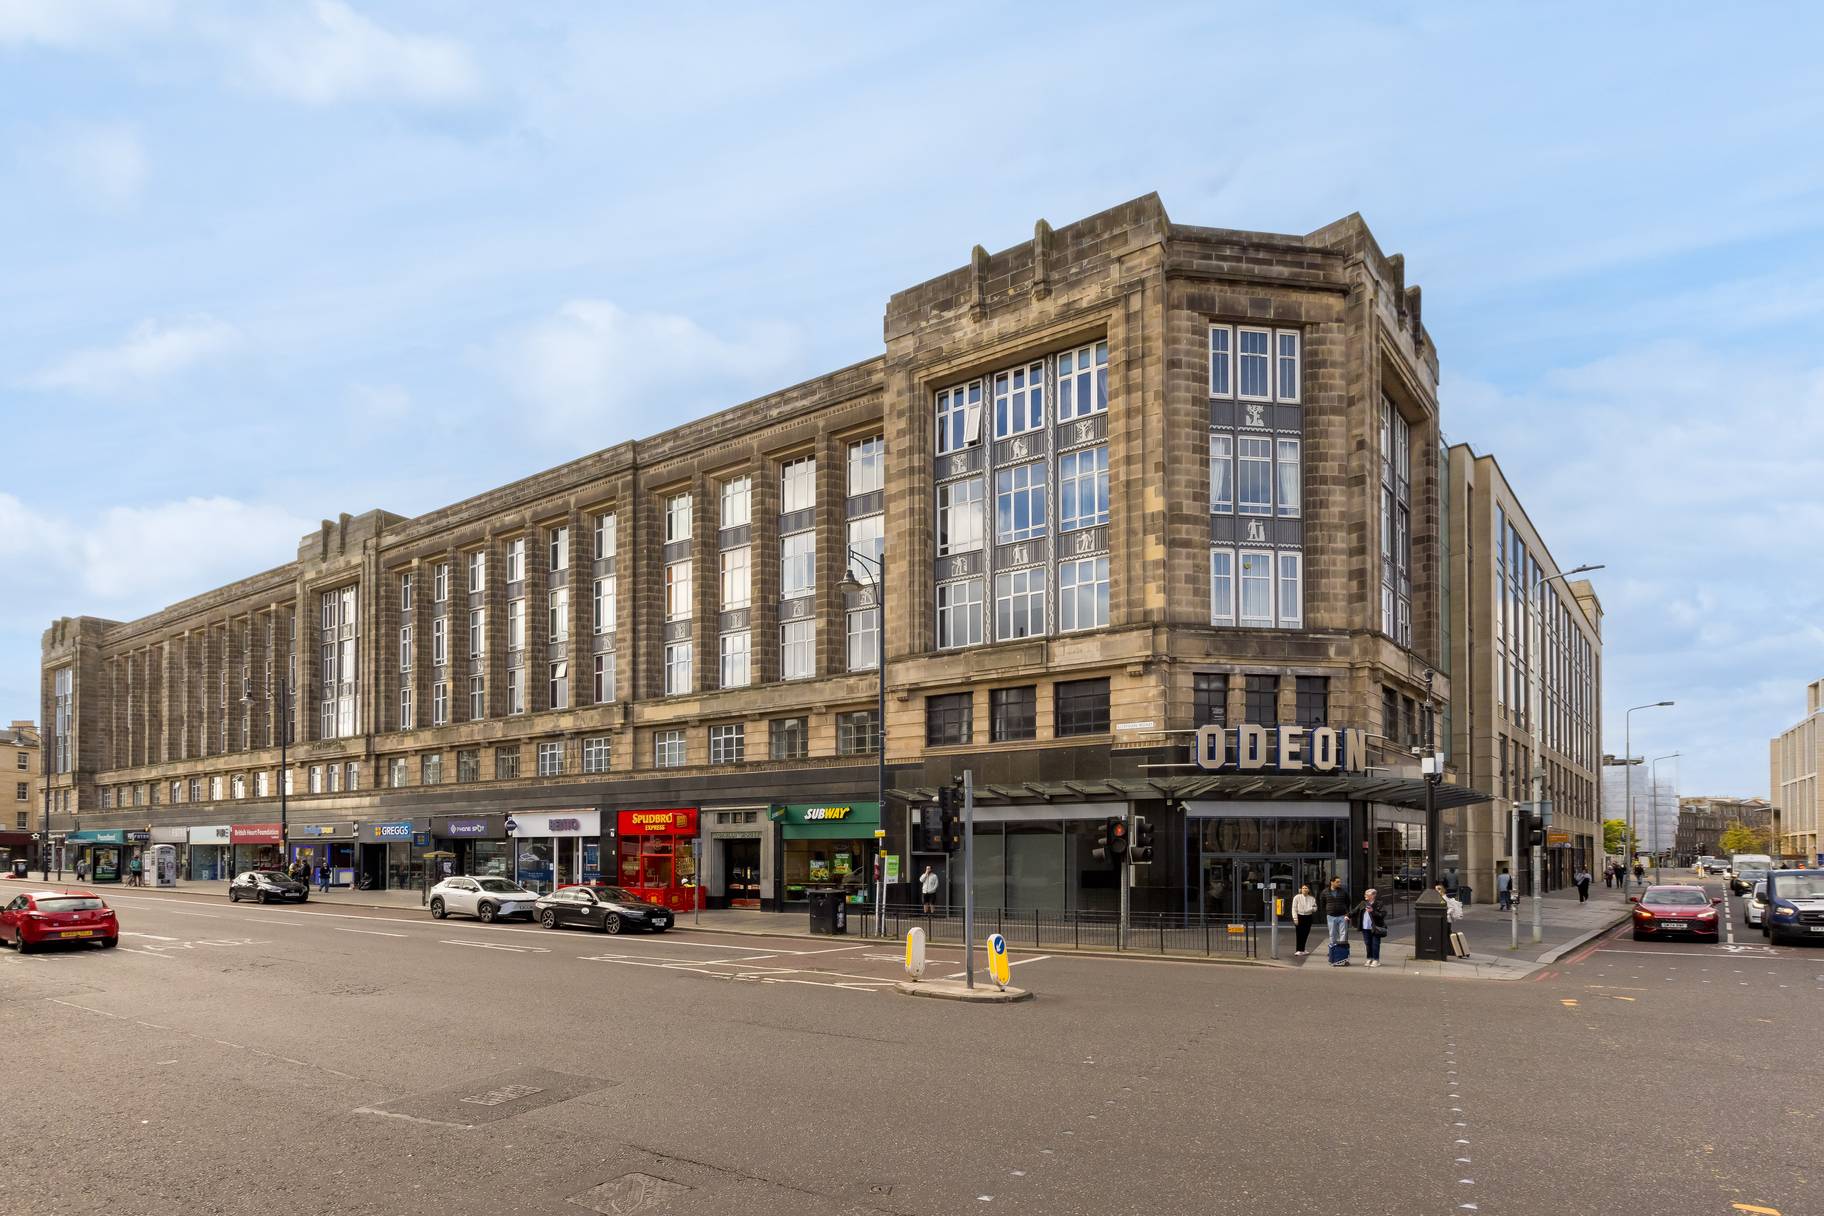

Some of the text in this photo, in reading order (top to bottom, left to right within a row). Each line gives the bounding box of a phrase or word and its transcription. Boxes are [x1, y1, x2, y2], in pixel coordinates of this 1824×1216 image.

[1196, 724, 1366, 772] ODEON
[632, 812, 673, 824] SPUDBRO
[804, 807, 850, 820] SUBWAY
[381, 826, 409, 835] GREGGS
[472, 824, 485, 832] SPOT
